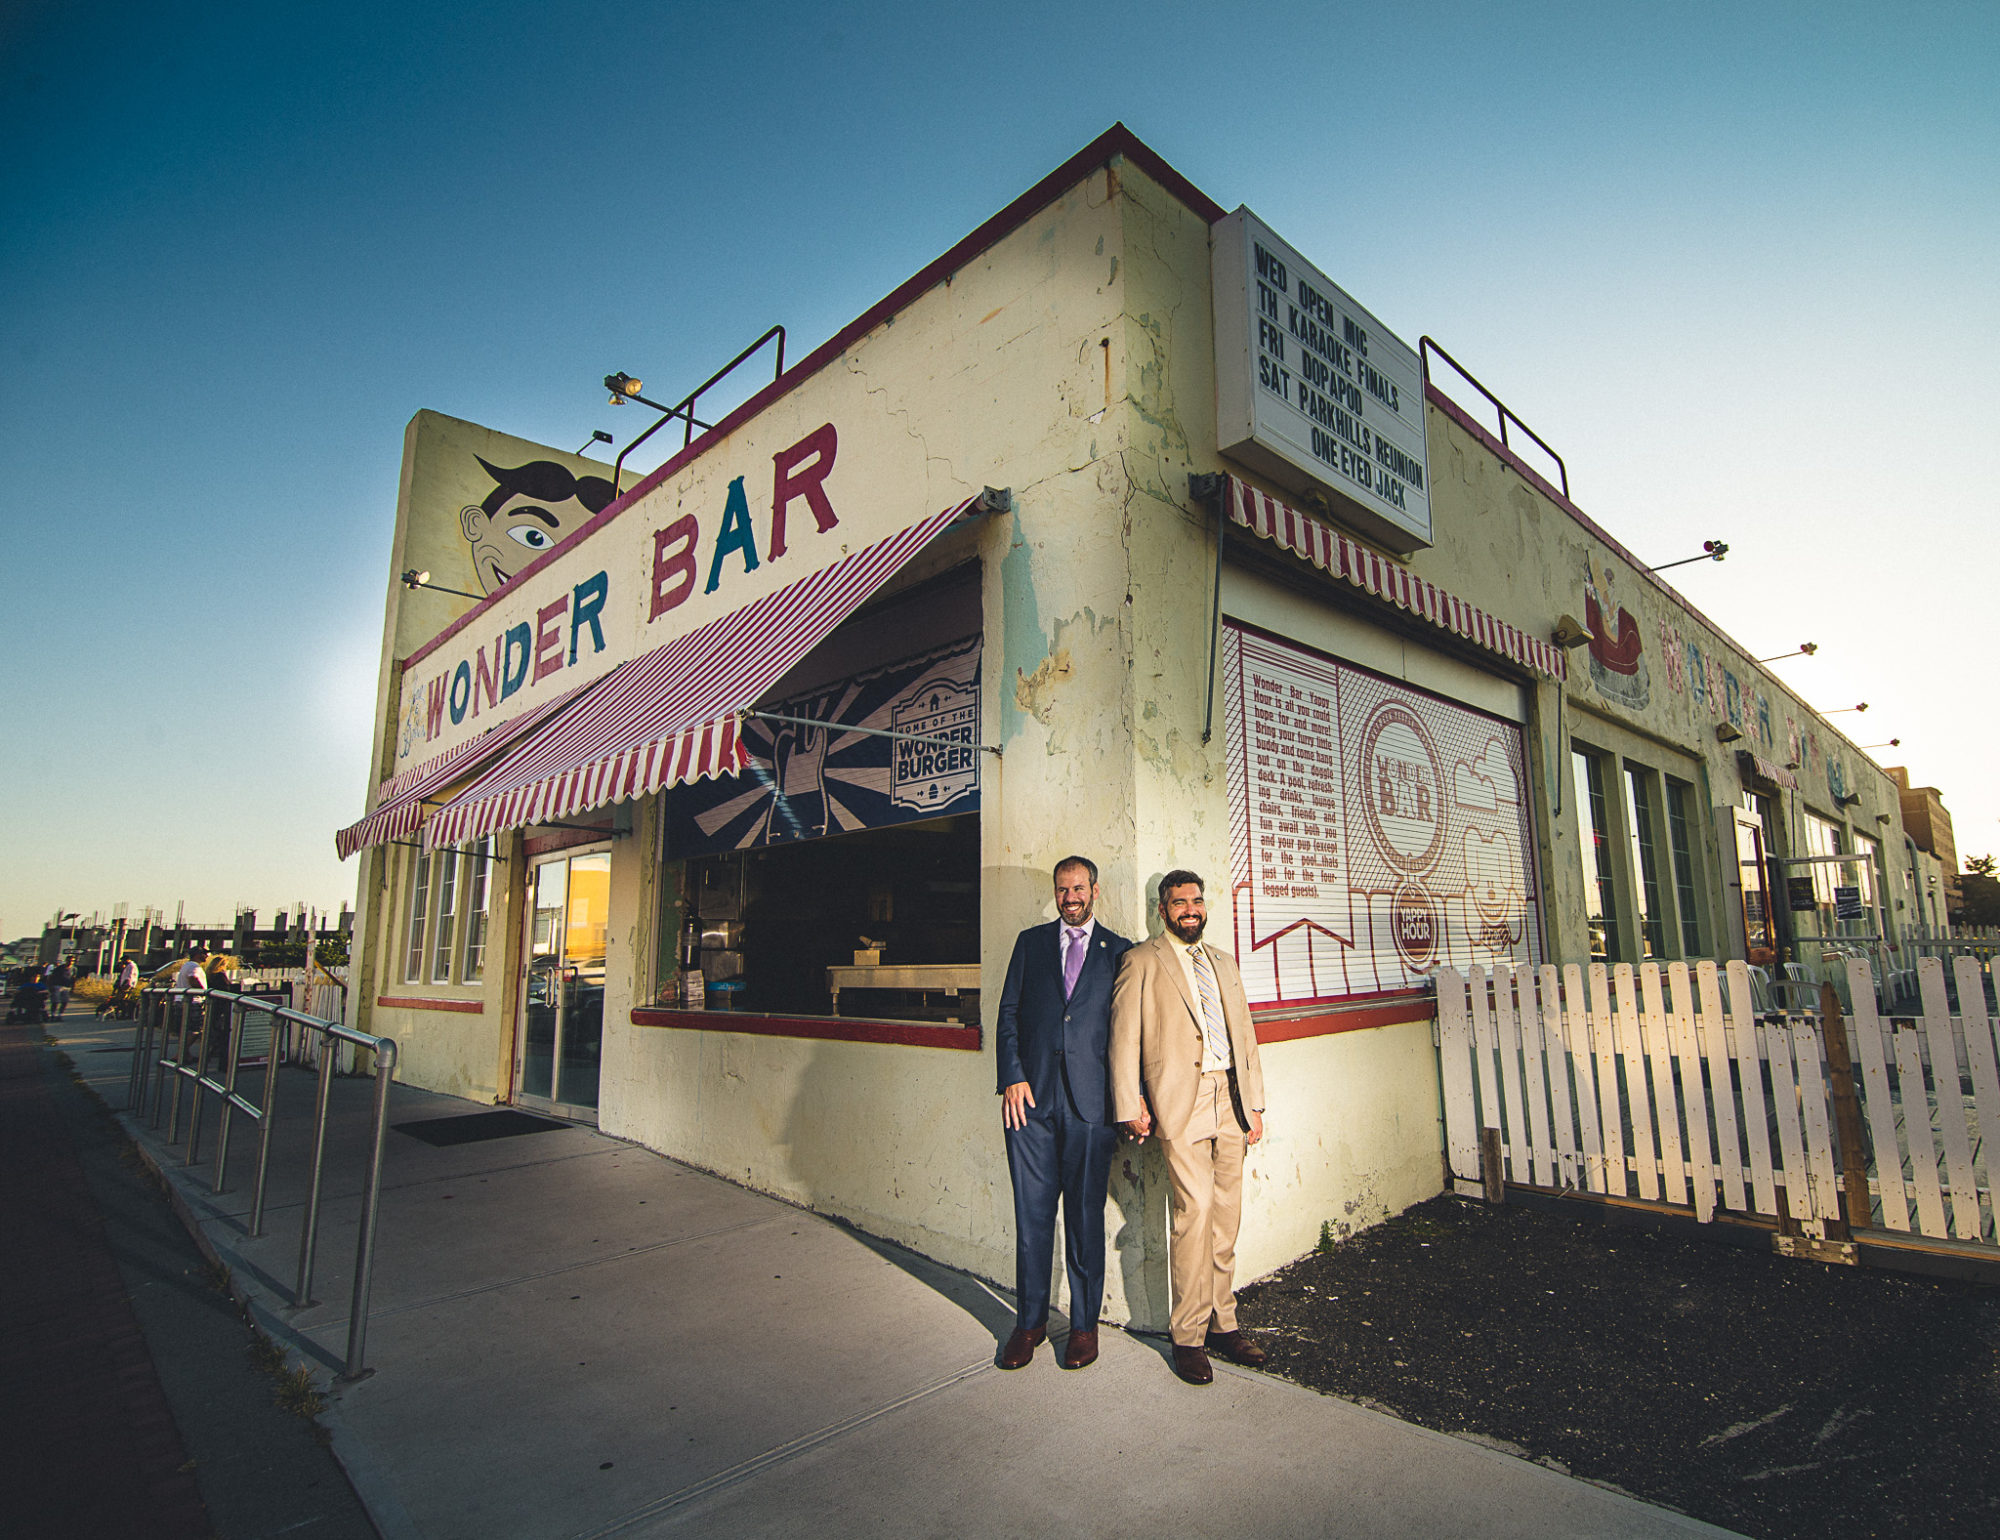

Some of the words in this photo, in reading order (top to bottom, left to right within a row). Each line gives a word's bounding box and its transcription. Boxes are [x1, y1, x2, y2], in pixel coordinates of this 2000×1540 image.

[1255, 242, 1287, 292] WED
[1299, 280, 1334, 331] OPEN
[1344, 316, 1367, 356] MIC
[1257, 281, 1278, 321] TH
[1289, 306, 1350, 376] KARAOKE
[1358, 360, 1398, 412] FINALS
[1259, 318, 1284, 360] FRI
[1302, 351, 1362, 416] DOPAPOD
[1260, 355, 1290, 400] SAT
[1300, 382, 1370, 454] PARKHILLS
[1376, 436, 1424, 490] REUNION
[1312, 428, 1338, 468] ONE
[1342, 448, 1372, 488] EYED
[1375, 470, 1406, 510] JACK
[426, 570, 608, 743] WONDER
[647, 422, 839, 624] BAR
[1253, 674, 1282, 694] Wonder
[1290, 685, 1302, 699] Bar
[1310, 691, 1329, 709] Yappy
[1254, 689, 1271, 705] Hour
[1276, 696, 1281, 708] is
[1286, 700, 1294, 712] all
[1298, 705, 1310, 716] you
[1313, 710, 1330, 722] could
[898, 722, 926, 734] HOME
[932, 716, 946, 726] OF
[952, 710, 974, 722] THE
[1255, 705, 1273, 721] hope
[1279, 712, 1289, 725] for
[1294, 718, 1306, 730] and
[1311, 723, 1330, 736] more!
[1256, 720, 1276, 738] Bring
[1279, 729, 1294, 741] your
[1298, 731, 1314, 747] furry
[1317, 736, 1332, 750] little
[898, 726, 972, 760] WONDER
[1256, 736, 1278, 754] buddy
[1281, 745, 1294, 756] and
[1297, 748, 1314, 761] come
[1316, 751, 1332, 766] hang
[898, 748, 972, 781] BURGER
[1258, 755, 1269, 766] out
[1277, 759, 1286, 770] on
[1293, 761, 1304, 773] the
[1375, 753, 1432, 785] WONDER
[1258, 769, 1277, 783] deck.
[1280, 773, 1285, 785] A
[1288, 776, 1306, 790] pool,
[1308, 780, 1334, 794] refresh-
[1259, 784, 1270, 799] ing
[1280, 788, 1304, 805] drinks,
[1312, 794, 1335, 809] lounge
[1260, 801, 1283, 817] chairs,
[1292, 806, 1316, 820] friends
[1324, 812, 1336, 824] and
[1377, 775, 1434, 823] BAR
[1260, 816, 1272, 830] fun
[1279, 820, 1298, 833] await
[1304, 822, 1320, 836] both
[1325, 827, 1336, 838] you
[1261, 834, 1275, 846] and
[1278, 837, 1294, 848] your
[1298, 839, 1310, 851] pup
[1313, 839, 1337, 853] (except
[1262, 848, 1272, 862] for
[1281, 851, 1293, 864] the
[1263, 865, 1276, 880] just
[1284, 867, 1294, 880] for
[1302, 869, 1314, 881] the
[1321, 870, 1337, 883] four-
[1263, 882, 1288, 897] legged
[1292, 885, 1319, 898] guests).
[1400, 908, 1428, 922] YAPPY
[1402, 922, 1430, 940] HOUR
